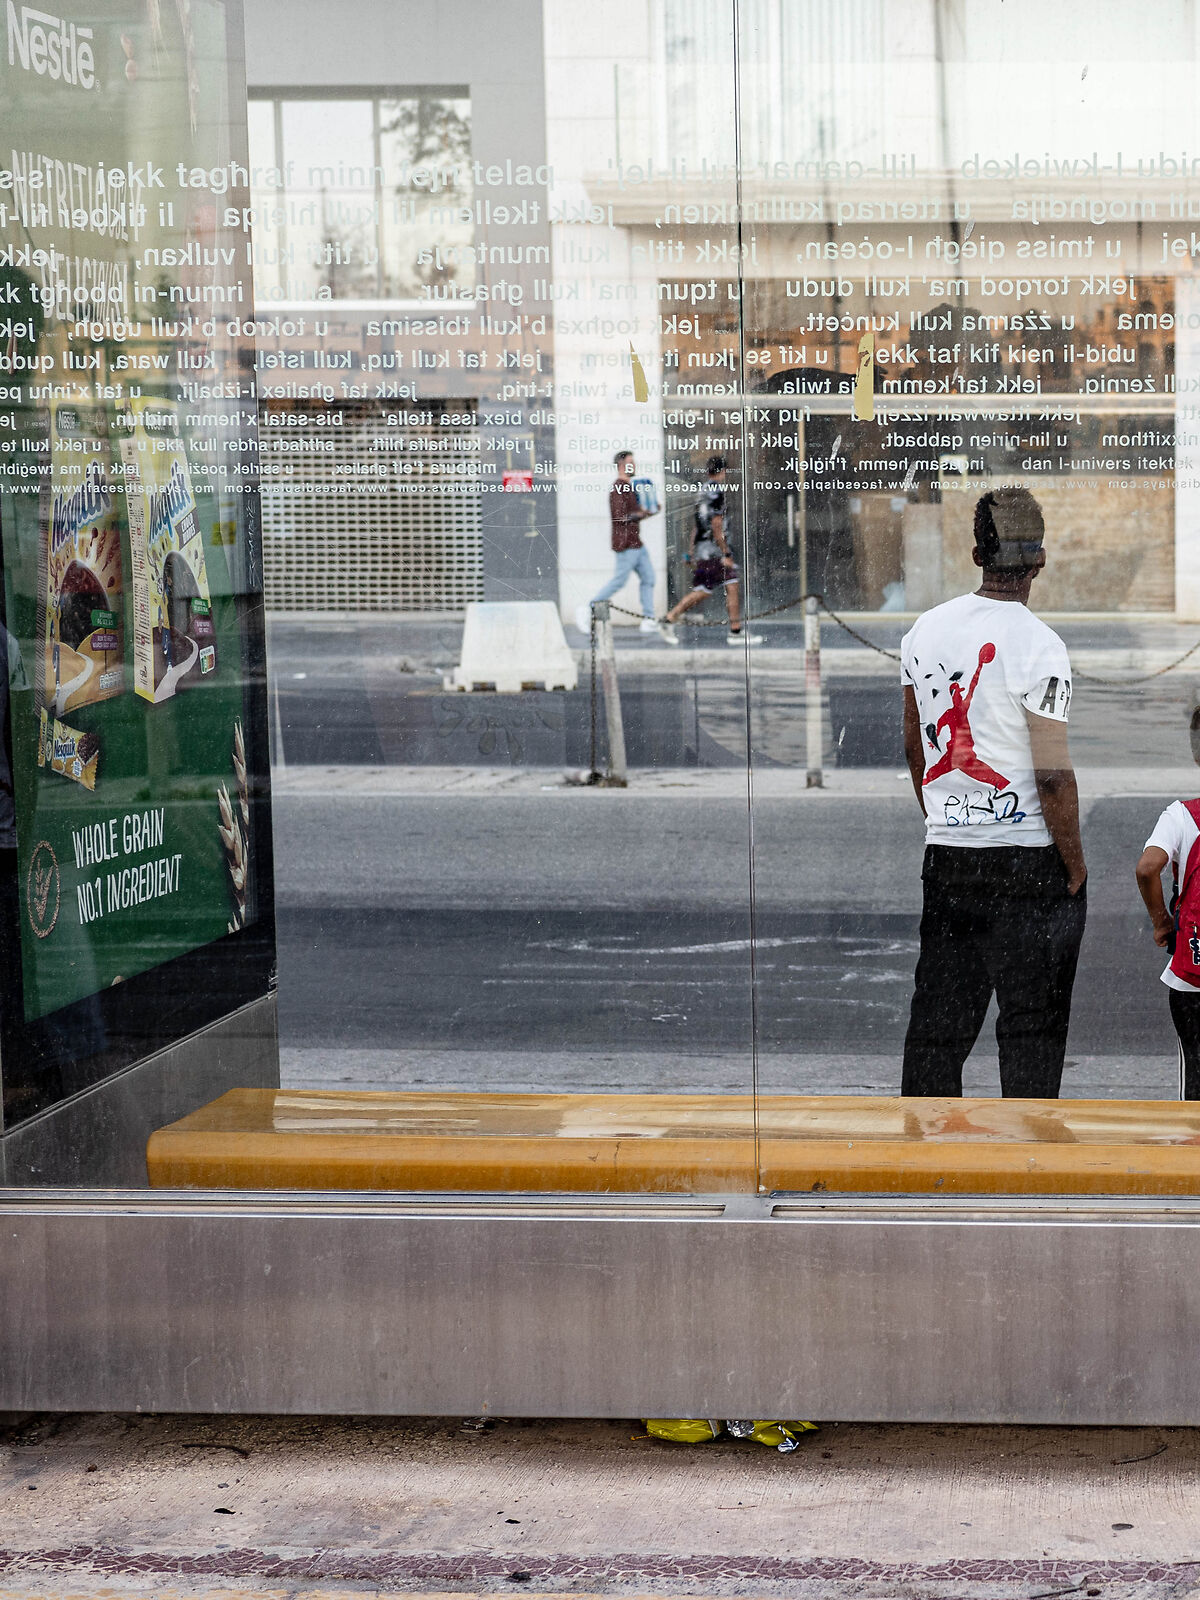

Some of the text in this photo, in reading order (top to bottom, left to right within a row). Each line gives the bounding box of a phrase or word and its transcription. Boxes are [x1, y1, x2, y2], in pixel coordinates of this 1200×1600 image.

[97, 159, 555, 195] jekk tagħraf minn fejn telaq
[133, 280, 244, 303] in-numri
[254, 280, 334, 302] kollha
[875, 343, 1137, 365] ekk taf kif kien il-bidu
[150, 438, 185, 456] jekk
[189, 437, 218, 452] kull
[1021, 455, 1053, 471] dan
[1058, 455, 1132, 470] l-univers
[51, 482, 215, 498] www.facesdisplays.com
[72, 808, 165, 869] WHOLE GRAIN
[76, 854, 183, 925] NO.1 INGREDIENT
